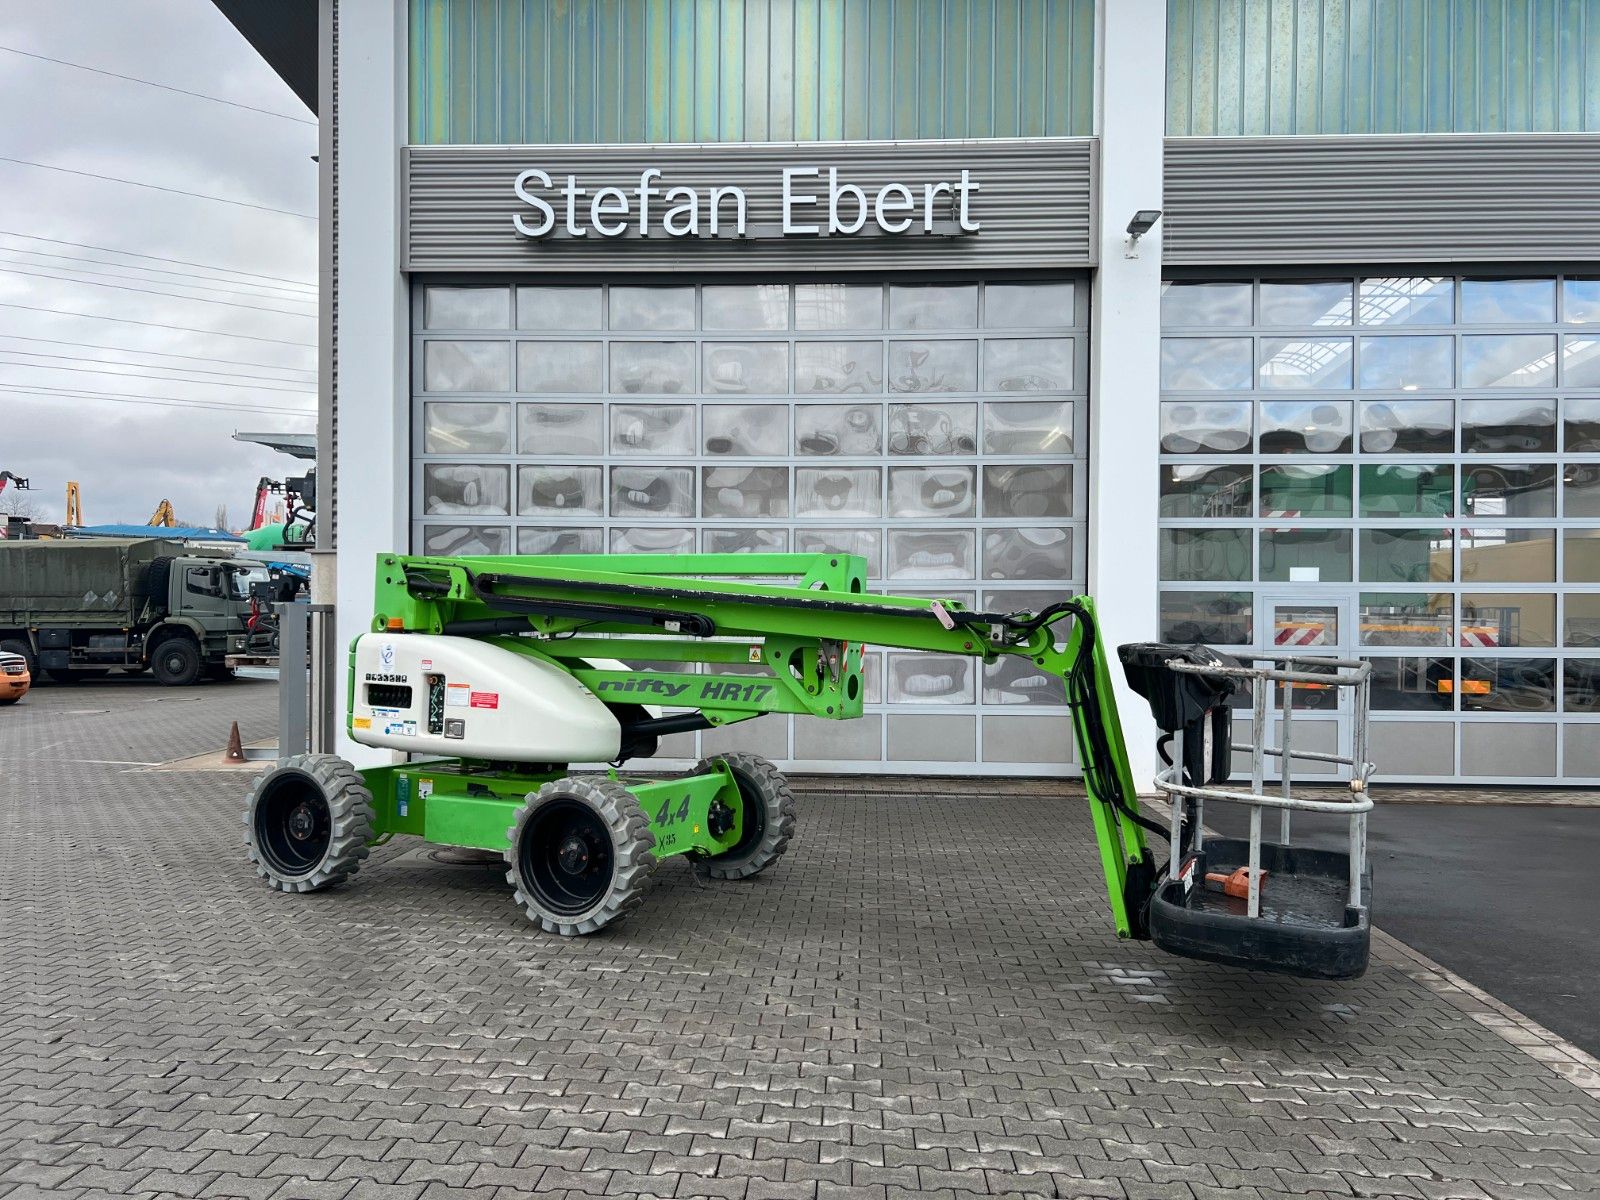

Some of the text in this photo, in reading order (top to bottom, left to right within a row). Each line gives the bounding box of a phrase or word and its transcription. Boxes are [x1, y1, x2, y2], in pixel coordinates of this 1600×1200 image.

[512, 167, 980, 237] Stefan Ebert
[598, 679, 773, 703] nifty HR17
[655, 794, 691, 827] 4x4
